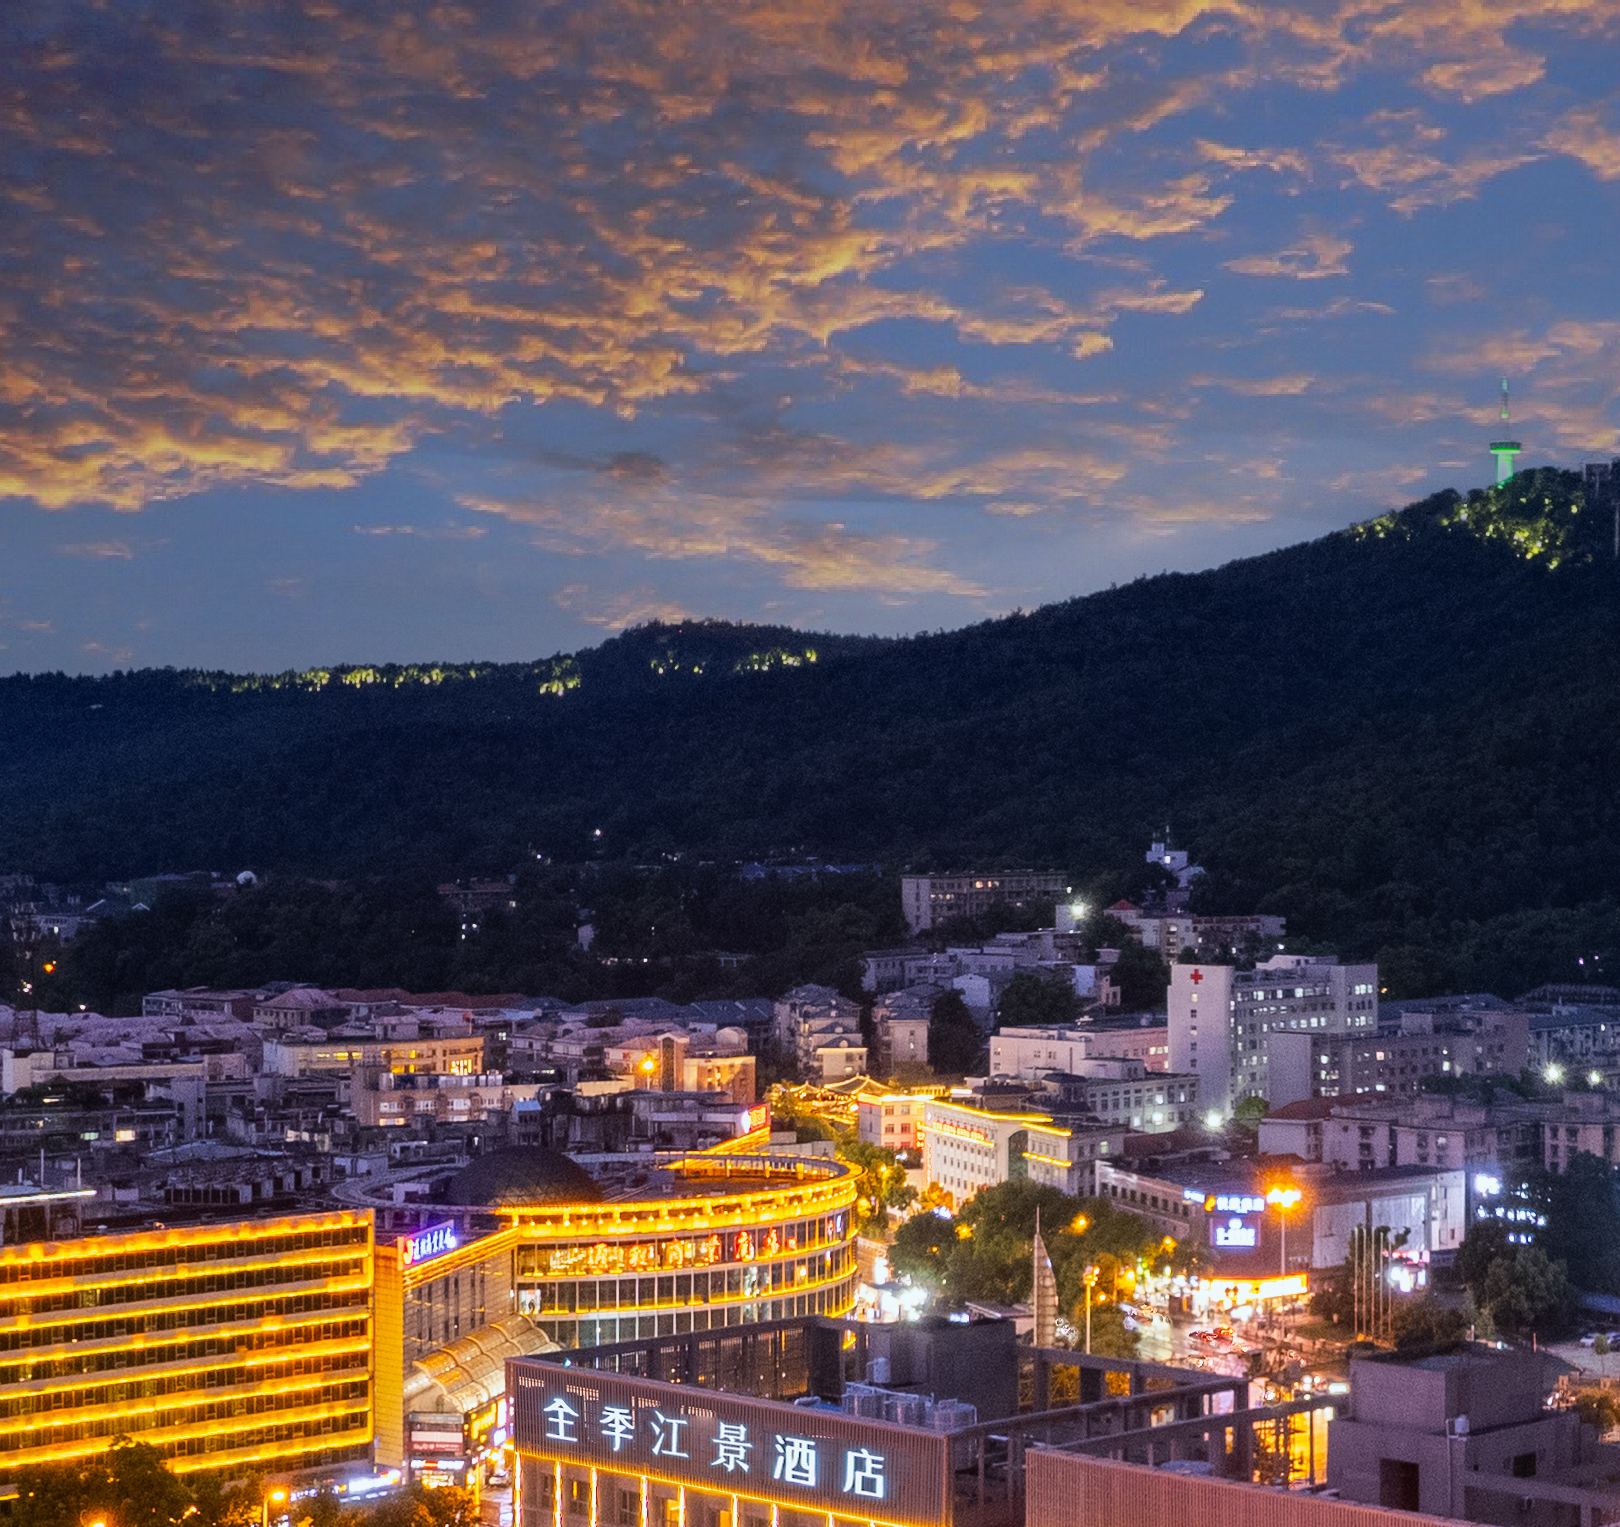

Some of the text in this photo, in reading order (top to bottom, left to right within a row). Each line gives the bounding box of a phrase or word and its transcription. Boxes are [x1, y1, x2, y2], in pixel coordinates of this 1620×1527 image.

[543, 1396, 886, 1499] 全季江景酒店
